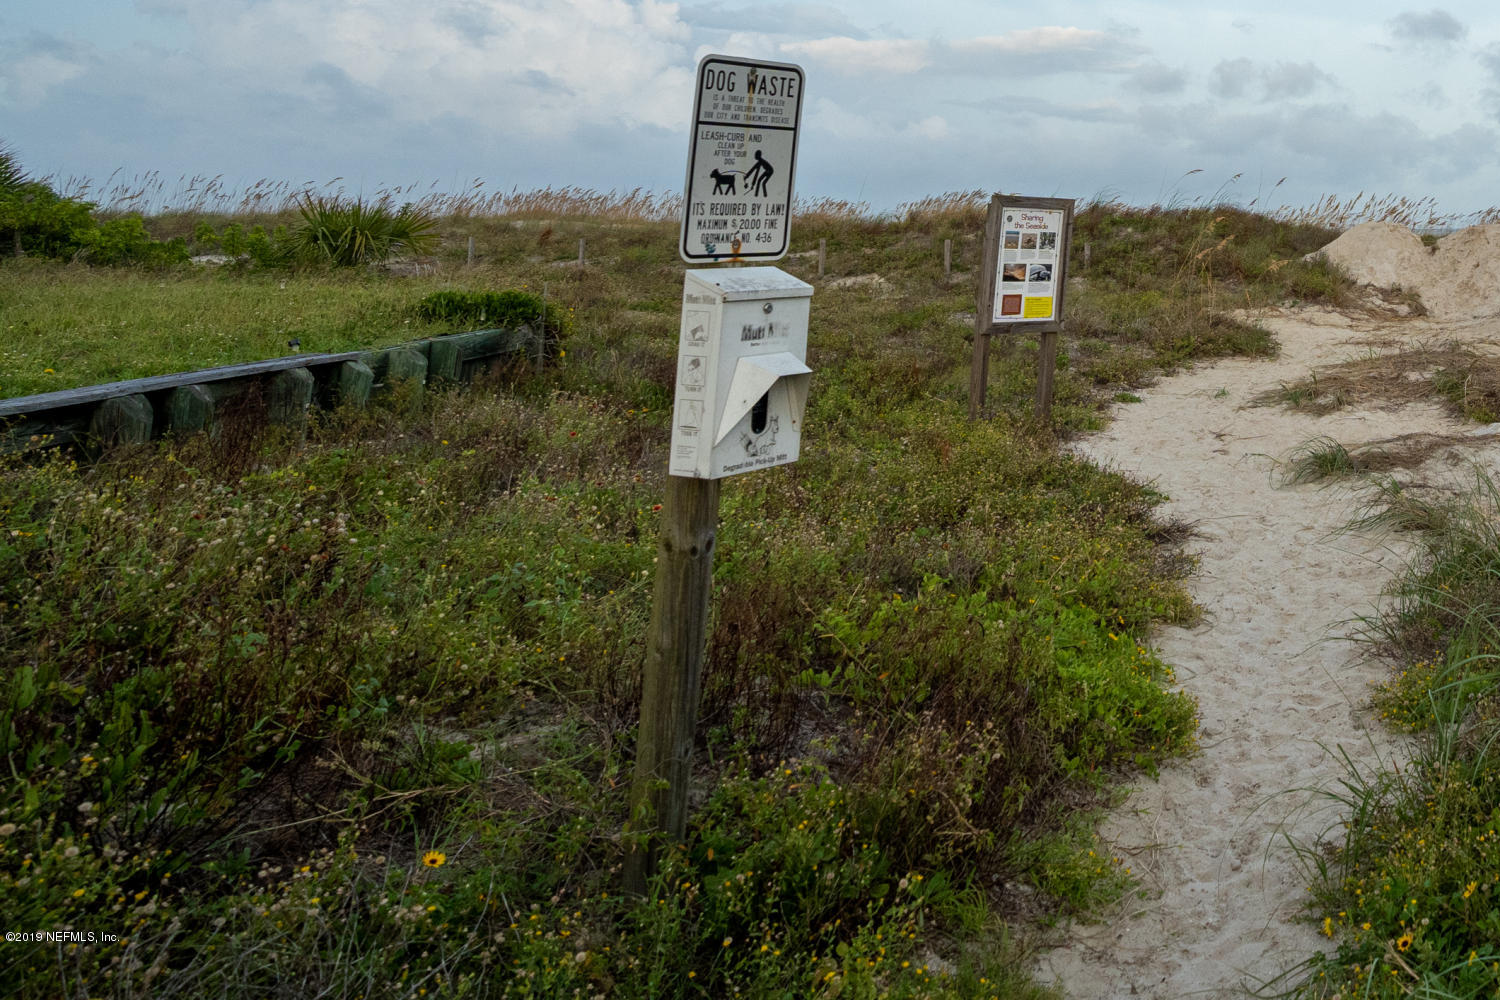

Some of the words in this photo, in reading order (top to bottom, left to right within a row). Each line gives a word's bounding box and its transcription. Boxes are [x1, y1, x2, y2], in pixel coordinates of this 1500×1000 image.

[706, 69, 736, 92] DOG
[747, 74, 795, 98] WASTE
[728, 95, 745, 103] THREAT
[757, 97, 765, 105] THE
[768, 98, 786, 106] HEALTH
[760, 106, 783, 115] DEGRADES
[731, 113, 741, 121] AND
[701, 131, 745, 142] LEASH-CURB
[748, 134, 763, 143] AND
[713, 149, 731, 157] AFTER
[733, 150, 747, 158] YOUR
[710, 202, 746, 215] REQUIRED
[751, 203, 762, 215] BY
[765, 203, 785, 216] LAW!
[1020, 213, 1044, 222] Sharing
[698, 218, 728, 230] MAXIMUM
[764, 218, 778, 229] FINE
[741, 232, 751, 243] NO.
[755, 232, 772, 243] 4-36
